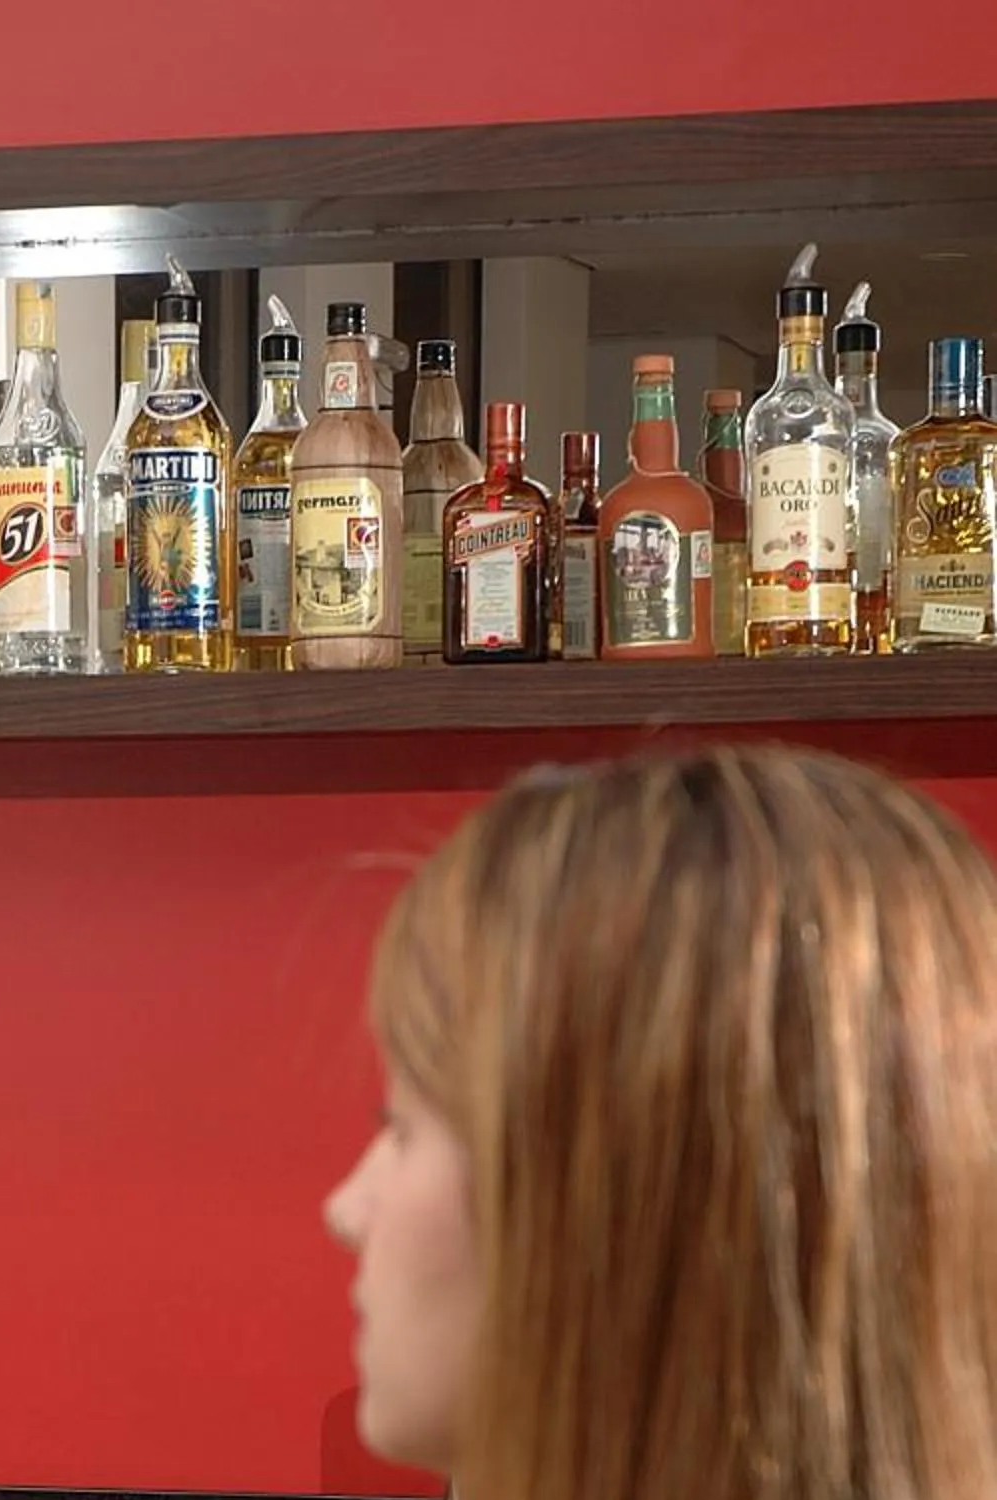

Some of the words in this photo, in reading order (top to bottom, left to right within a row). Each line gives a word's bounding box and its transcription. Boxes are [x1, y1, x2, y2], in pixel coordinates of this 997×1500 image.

[297, 494, 371, 514] german
[2, 512, 40, 561] 51
[458, 519, 529, 554] COINTREAU
